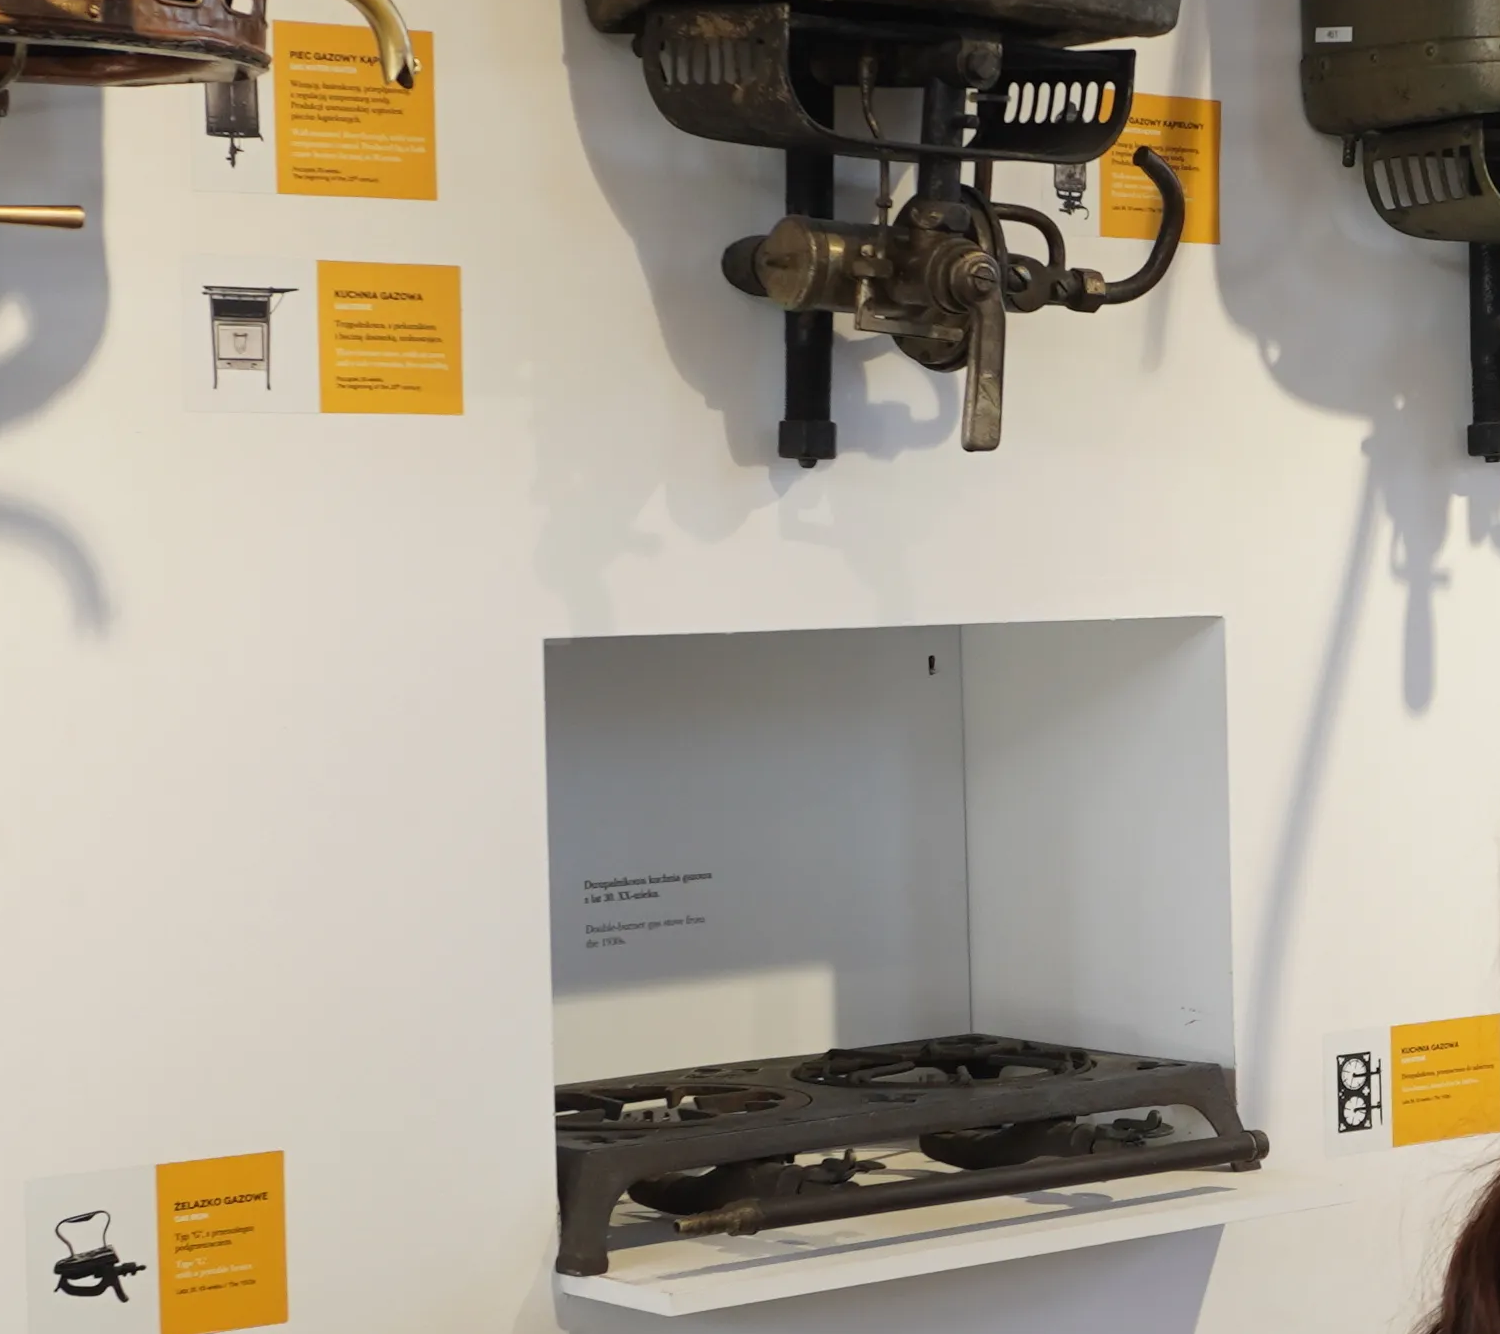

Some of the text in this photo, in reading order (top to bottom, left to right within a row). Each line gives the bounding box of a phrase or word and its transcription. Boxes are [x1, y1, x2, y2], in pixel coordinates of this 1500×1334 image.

[289, 50, 312, 60] PIEC
[313, 52, 358, 63] GAZOWY
[1129, 117, 1161, 126] GAZOWY
[334, 289, 424, 301] KUCHNIA GAZOWA
[1401, 1041, 1460, 1055] KUCHNIA GAZOWA
[223, 1191, 269, 1205] GAZOWE
